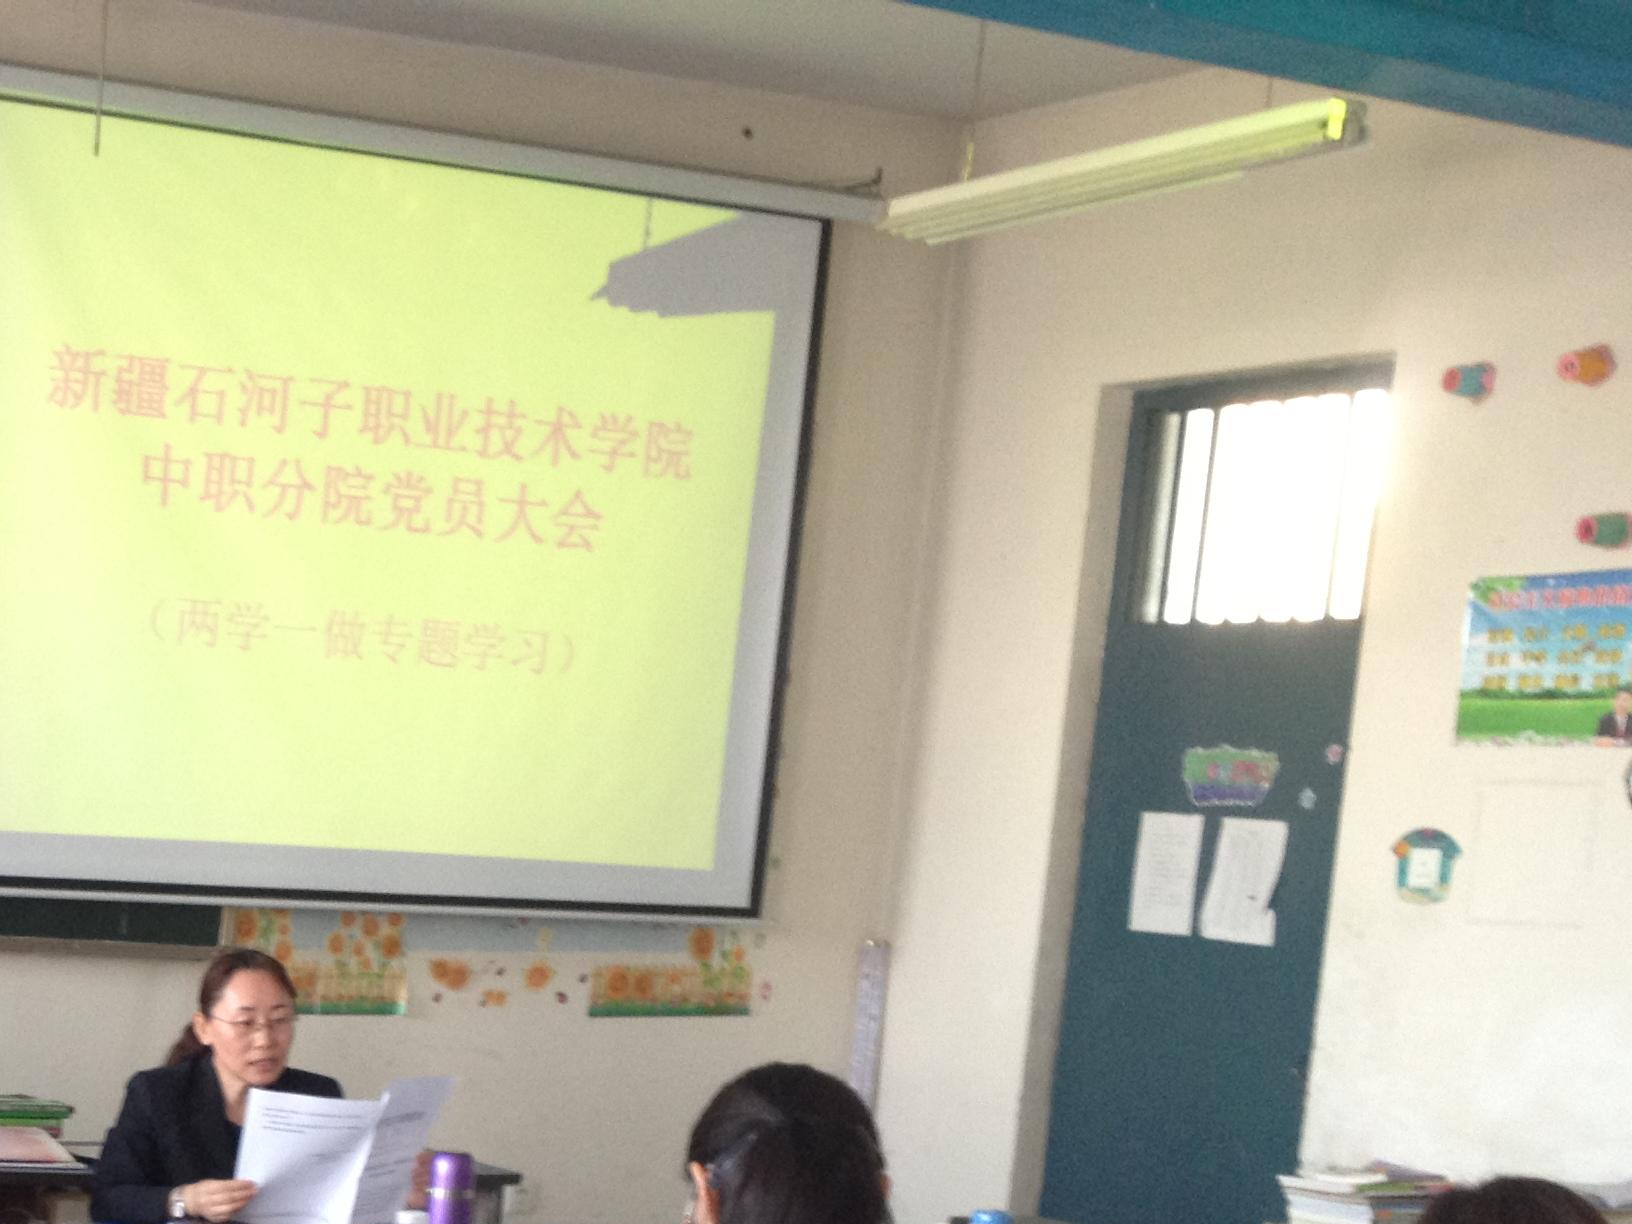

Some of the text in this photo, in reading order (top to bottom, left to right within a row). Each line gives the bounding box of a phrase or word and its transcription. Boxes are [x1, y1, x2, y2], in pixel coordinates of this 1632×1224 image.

[48, 345, 695, 481] 新疆石河子职业技术学院
[141, 444, 604, 552] 中职分院党员大会
